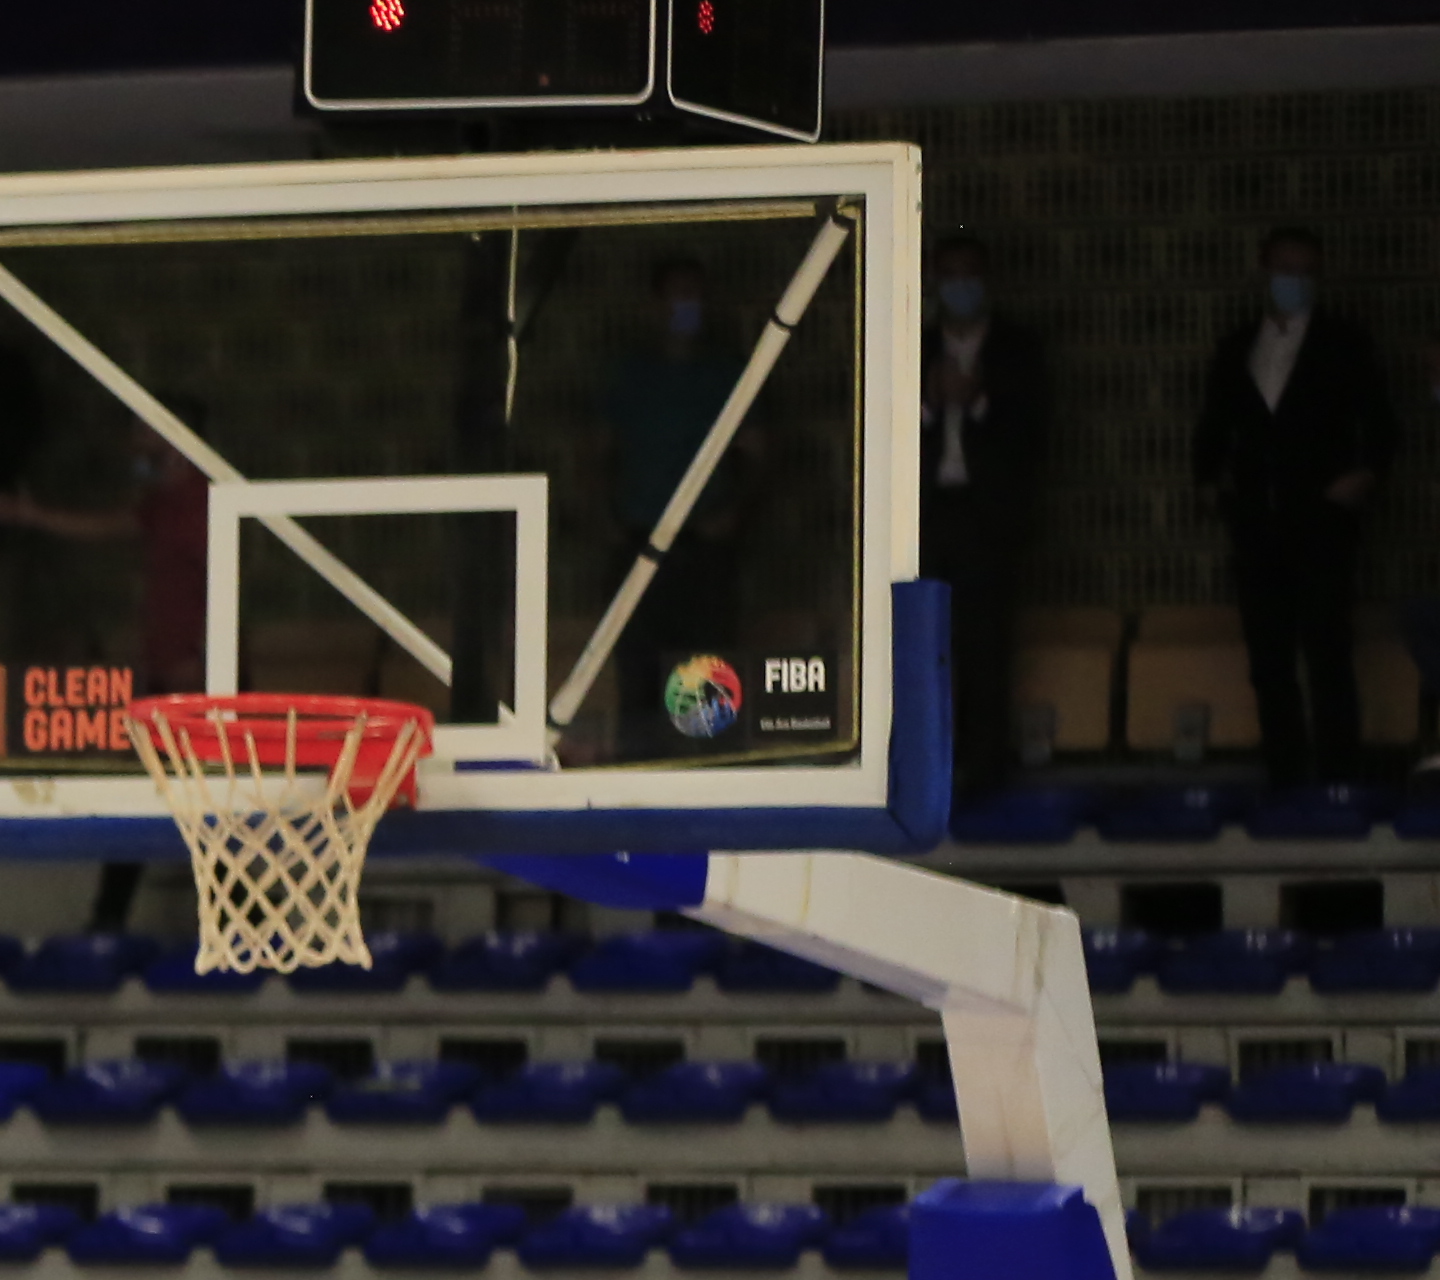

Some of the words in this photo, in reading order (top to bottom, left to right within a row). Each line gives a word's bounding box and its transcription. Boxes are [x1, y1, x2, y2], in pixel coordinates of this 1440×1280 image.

[24, 667, 132, 706] CLEAN
[765, 657, 825, 693] FIBA
[23, 709, 131, 750] GAME
